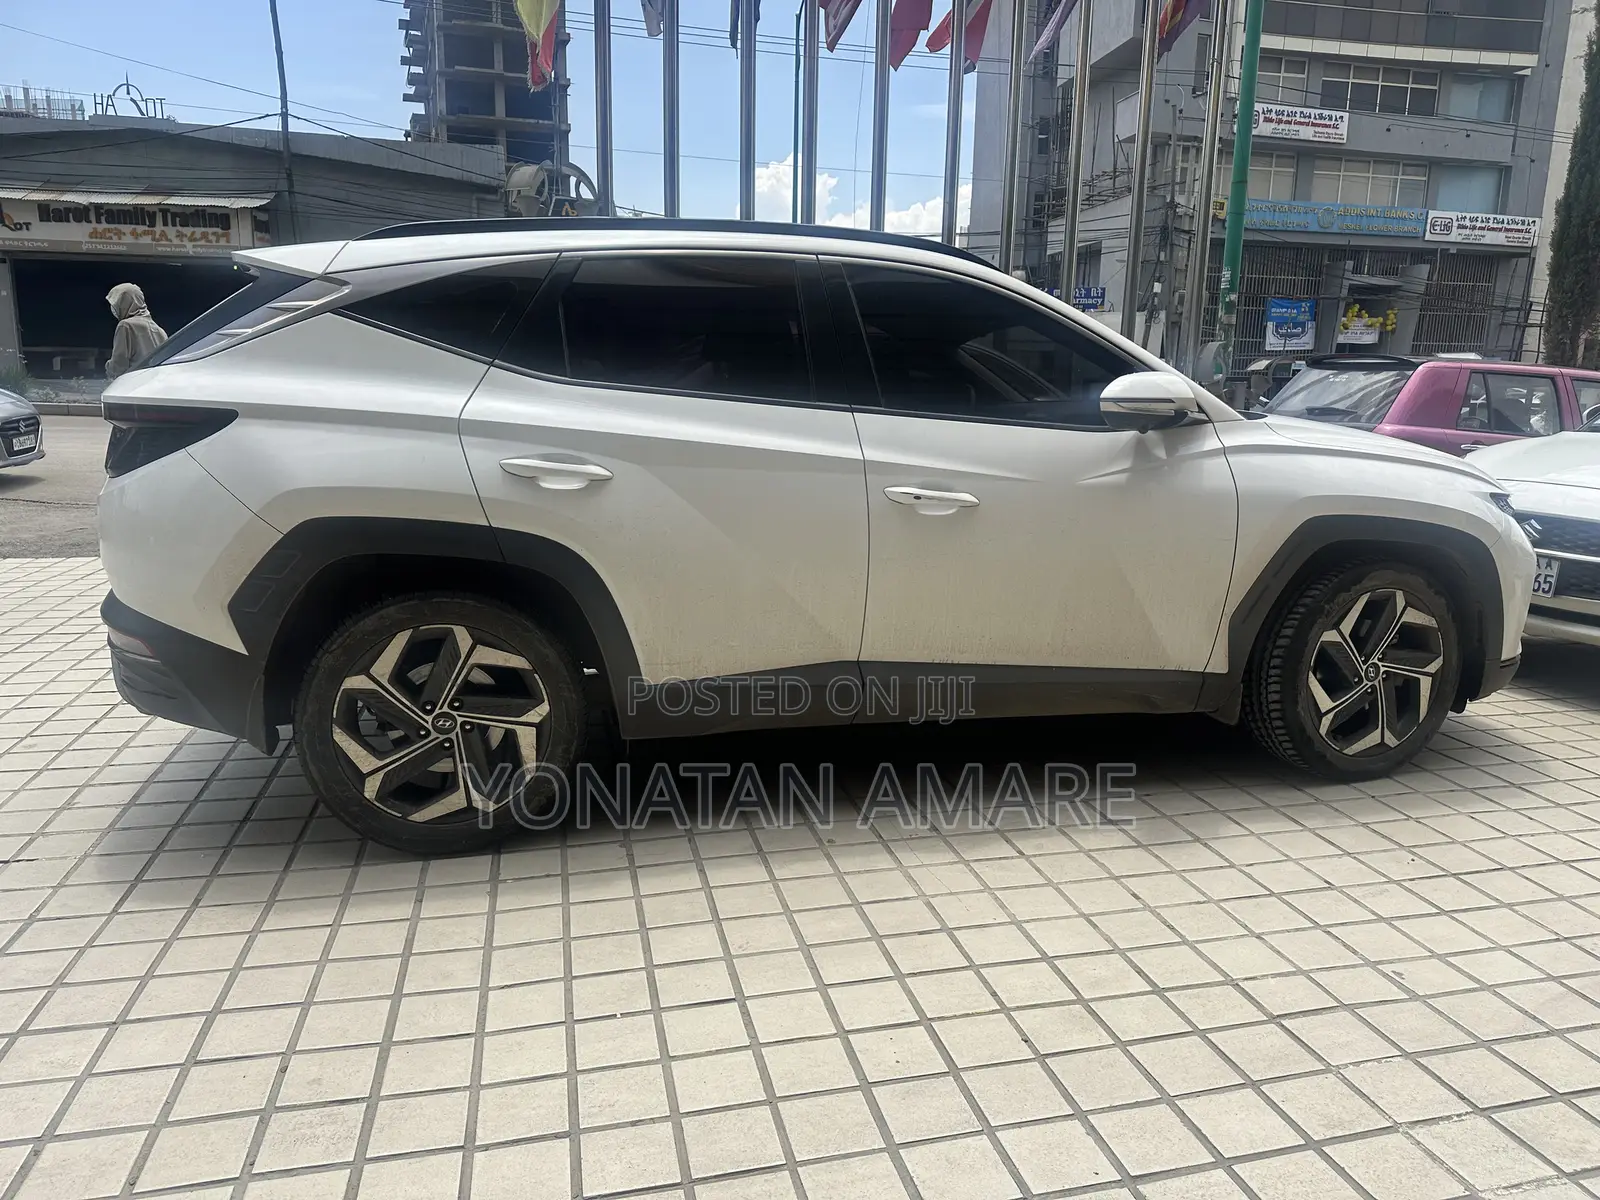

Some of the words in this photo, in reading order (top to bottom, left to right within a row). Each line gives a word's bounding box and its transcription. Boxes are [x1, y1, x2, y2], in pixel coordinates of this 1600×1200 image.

[94, 205, 157, 228] Family
[158, 207, 231, 231] Trading
[1338, 207, 1366, 217] ADDIS
[1384, 209, 1409, 219] BANK
[1339, 222, 1363, 231] ESKE
[1073, 297, 1103, 305] rmacy
